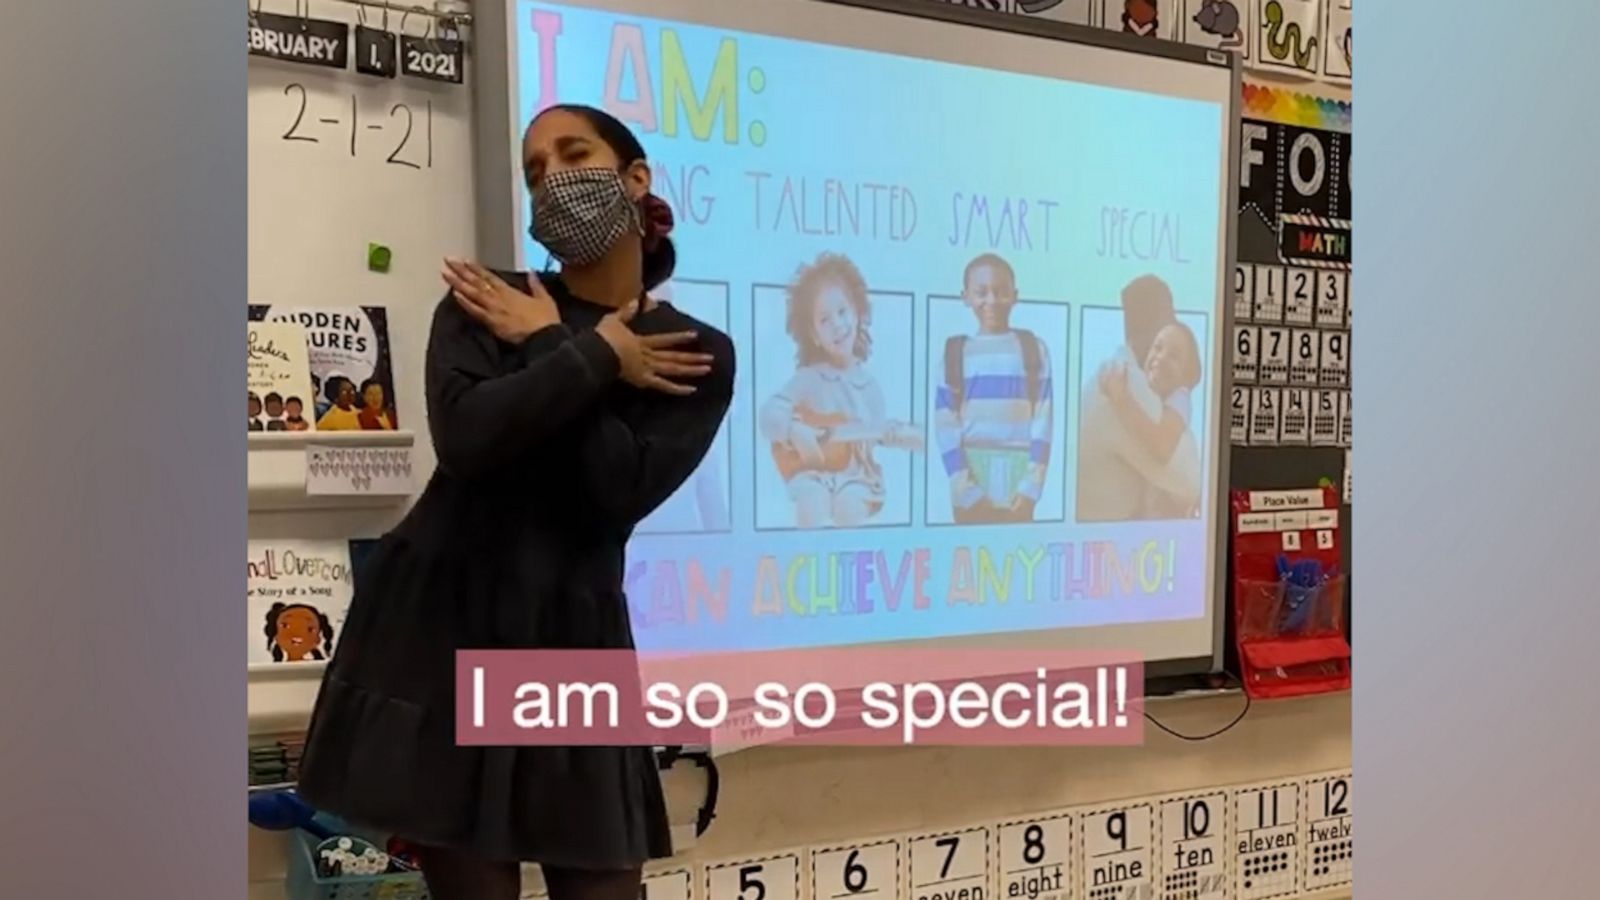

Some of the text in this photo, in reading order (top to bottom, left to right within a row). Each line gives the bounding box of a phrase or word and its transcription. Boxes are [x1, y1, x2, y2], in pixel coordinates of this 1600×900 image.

[247, 27, 339, 60] BRUARY
[407, 50, 456, 76] 2021
[531, 9, 767, 148] I AM:
[282, 83, 433, 169] 2-1-21
[1240, 122, 1351, 197] FO
[744, 171, 918, 242] TALENTED
[949, 192, 1059, 252] SMART
[1097, 206, 1191, 264] SPECIAL
[1299, 230, 1347, 257] MATH
[1267, 268, 1274, 297] 1
[1295, 272, 1308, 299] 2
[1326, 274, 1337, 300] 3
[306, 332, 367, 352] URES
[1238, 329, 1250, 356] 6
[1270, 331, 1281, 357] 7
[1300, 333, 1312, 359] 8
[1329, 335, 1343, 361] 9
[1259, 388, 1273, 409] 13
[1289, 389, 1302, 409] 14
[1318, 390, 1332, 411] 15
[626, 539, 1177, 628] CAN ACHIEVE ANYTHING!
[1259, 790, 1278, 829] 11
[1324, 780, 1348, 817] 12
[1106, 812, 1127, 850] 9
[1184, 800, 1210, 840] 10
[1022, 824, 1045, 864] 8
[1175, 843, 1213, 870] ten
[1239, 829, 1296, 854] eleven
[844, 850, 867, 893] 6
[935, 837, 960, 879] 7
[1094, 861, 1142, 886] nine
[738, 865, 766, 900] 5
[1008, 866, 1063, 899] eight
